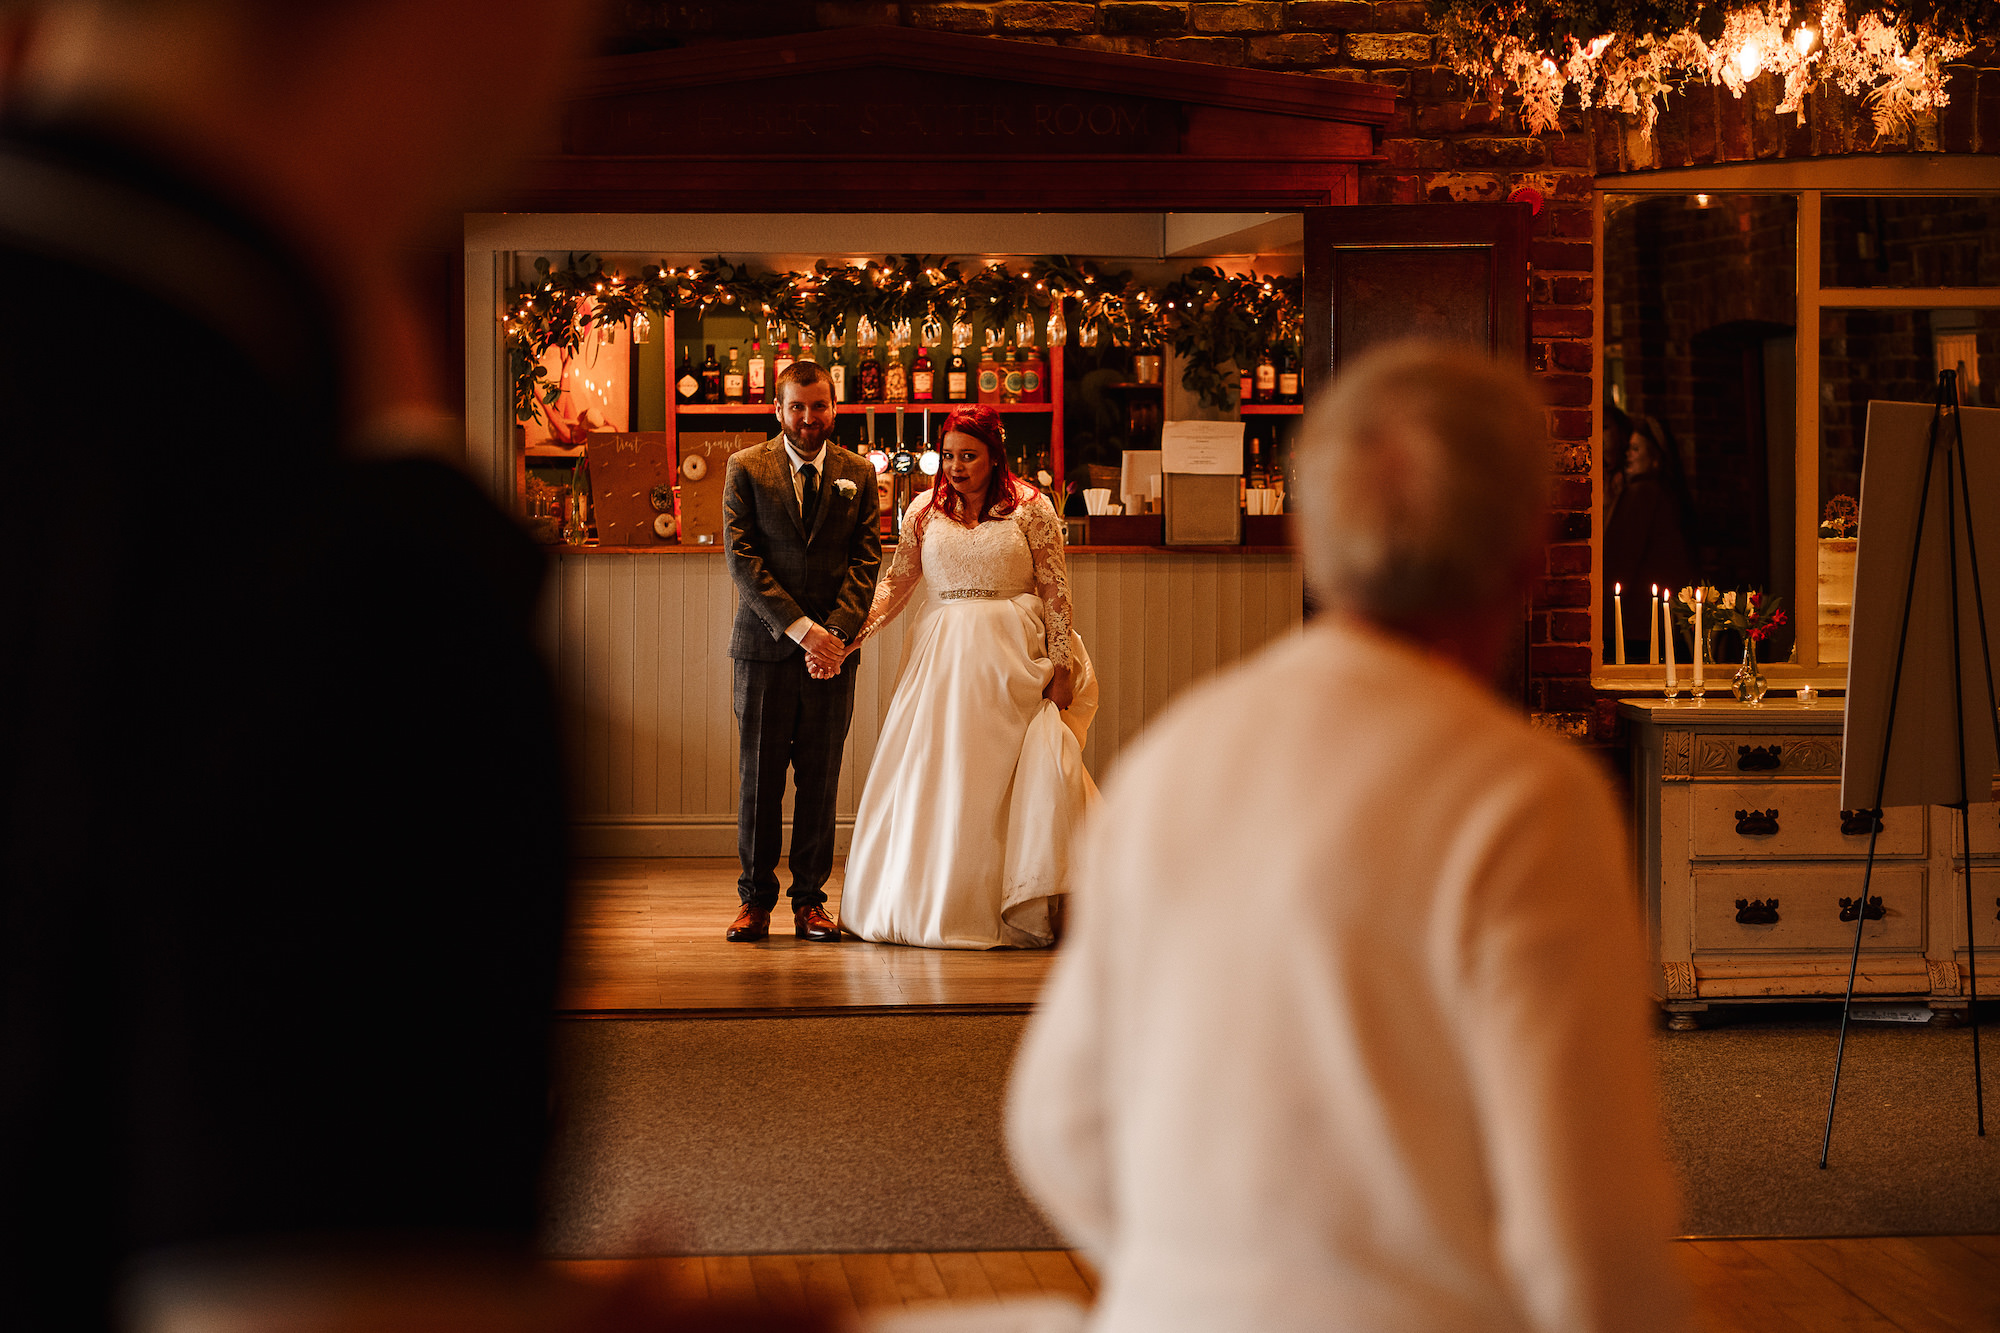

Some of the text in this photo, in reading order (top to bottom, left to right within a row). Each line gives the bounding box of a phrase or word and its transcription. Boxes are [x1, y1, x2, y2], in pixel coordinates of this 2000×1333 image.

[858, 103, 1016, 136] STATTER
[1034, 103, 1153, 136] ROOM
[615, 435, 641, 454] treat
